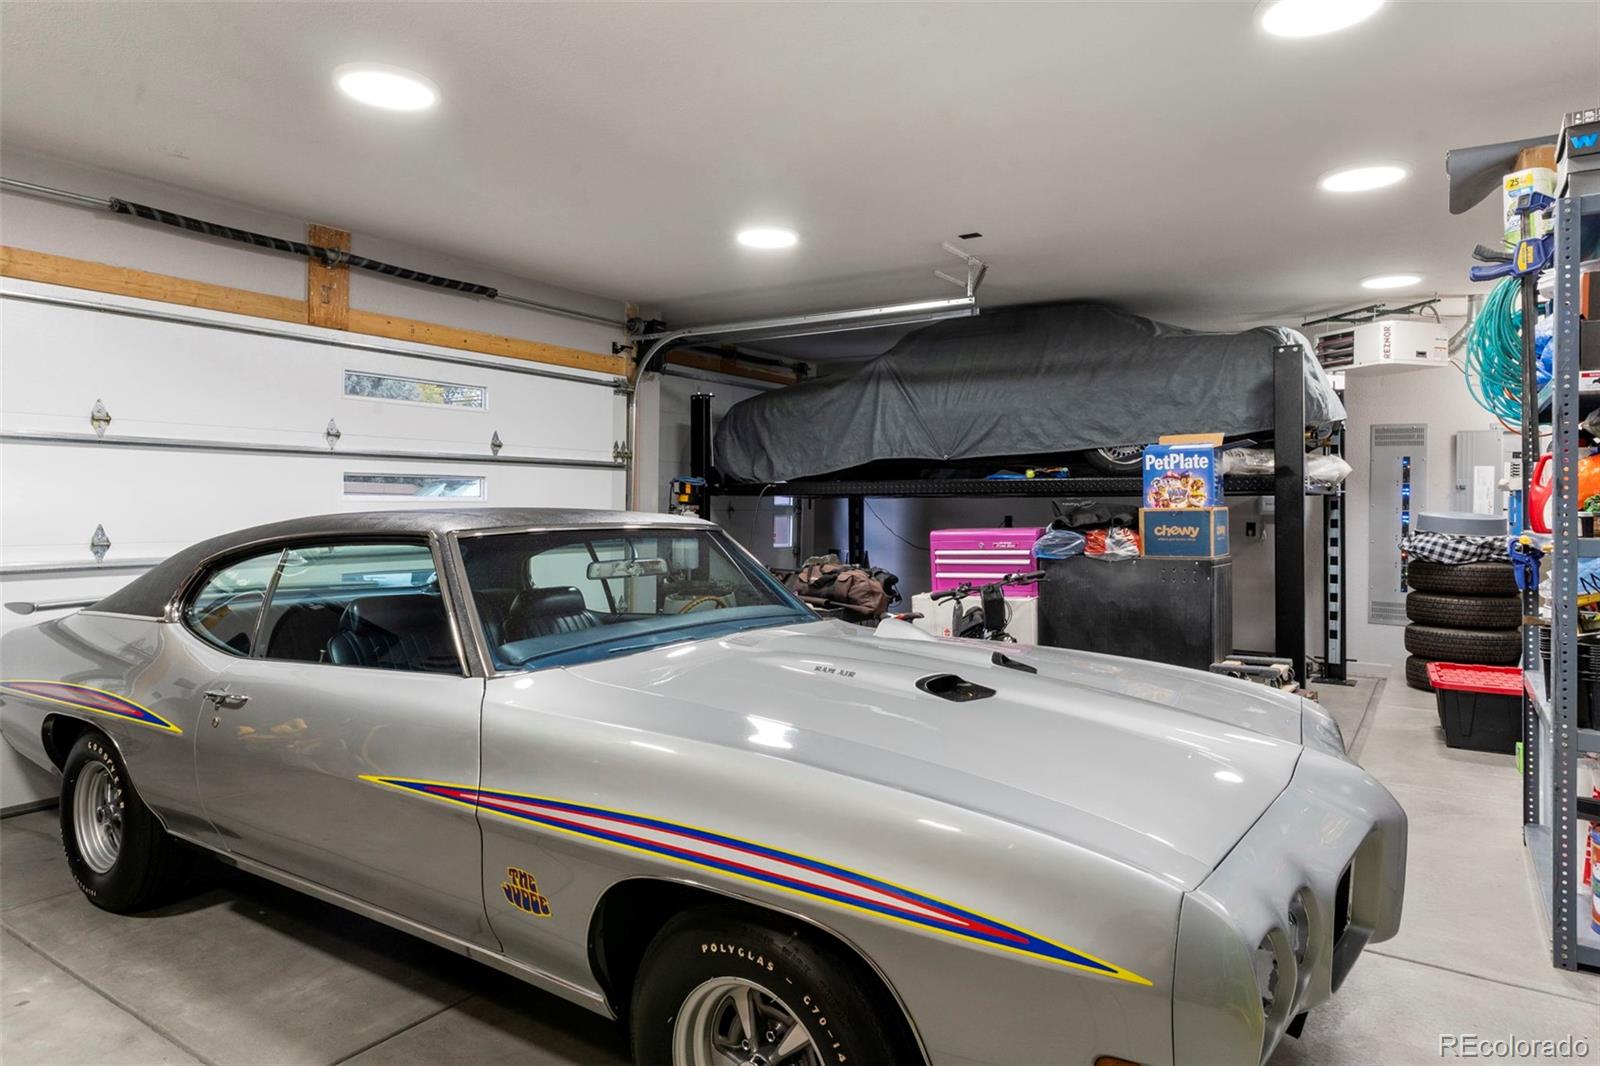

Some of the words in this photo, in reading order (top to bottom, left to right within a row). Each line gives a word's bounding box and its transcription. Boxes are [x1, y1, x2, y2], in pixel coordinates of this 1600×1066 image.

[1383, 326, 1392, 359] REZNOR
[1145, 453, 1209, 471] PetPlate
[1154, 524, 1200, 538] chewy
[507, 866, 538, 895] THE
[701, 943, 775, 972] POLYGLAS
